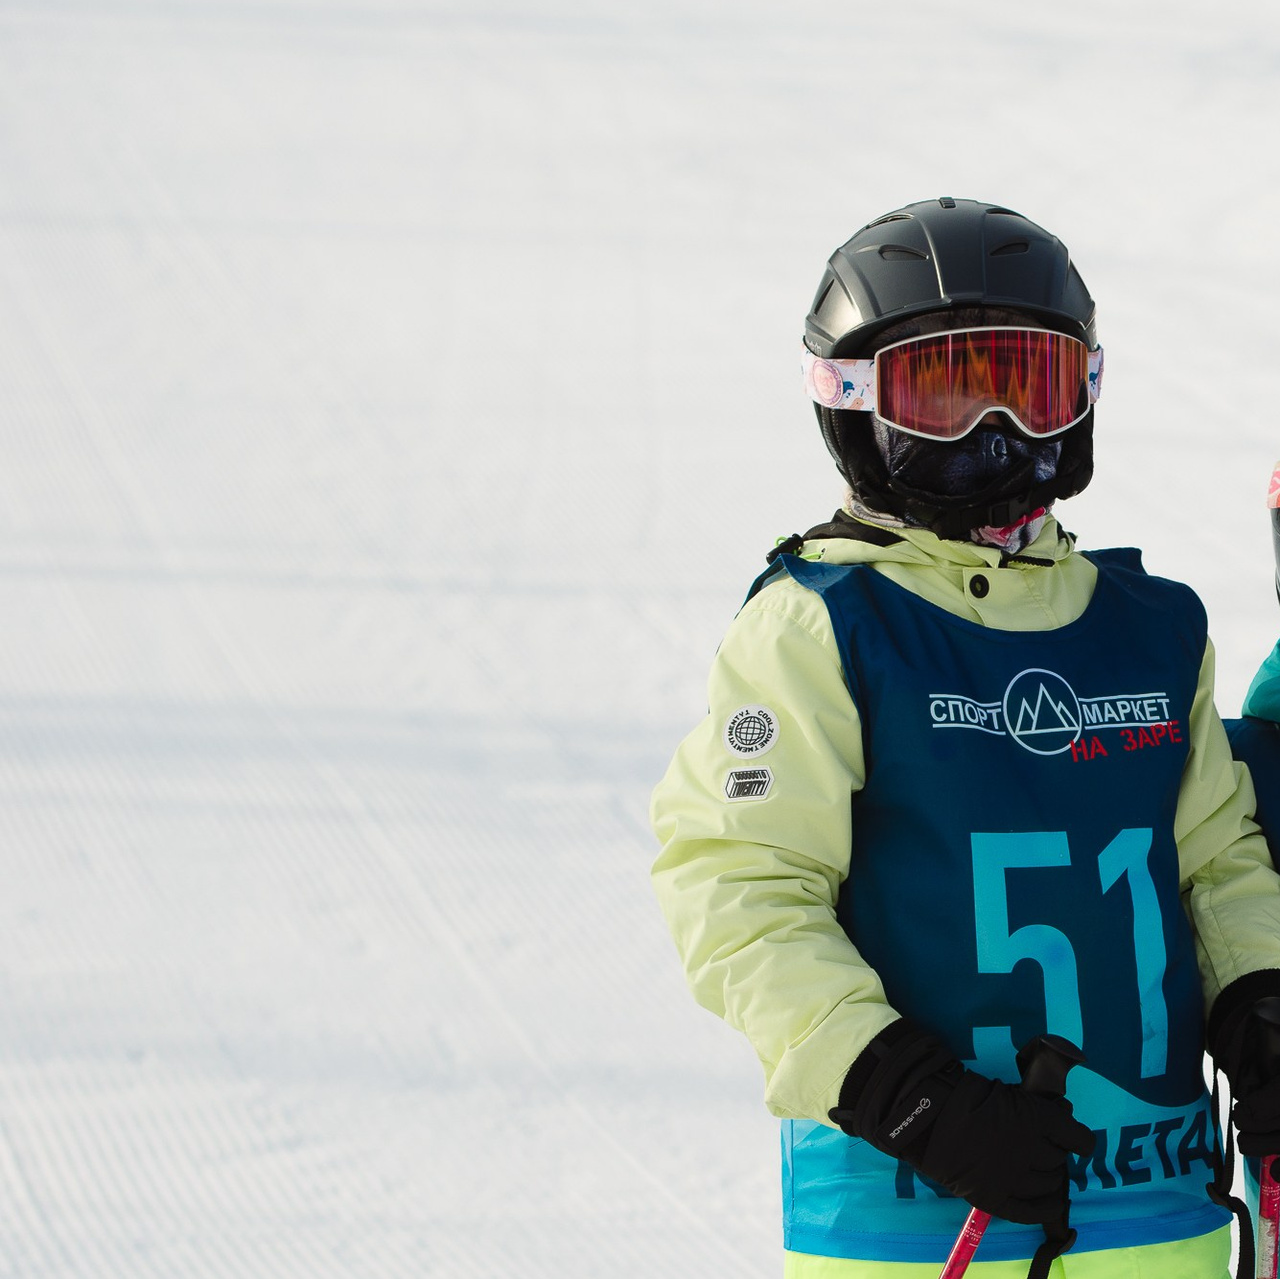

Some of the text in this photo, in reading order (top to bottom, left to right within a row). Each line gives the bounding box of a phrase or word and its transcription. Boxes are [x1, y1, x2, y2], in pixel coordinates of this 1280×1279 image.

[929, 698, 1171, 730] СПОРТ МАРКЕТ
[1069, 720, 1184, 763] НА ЗАРЕ
[970, 827, 1168, 1083] 51
[889, 1106, 923, 1139] GLISSADE
